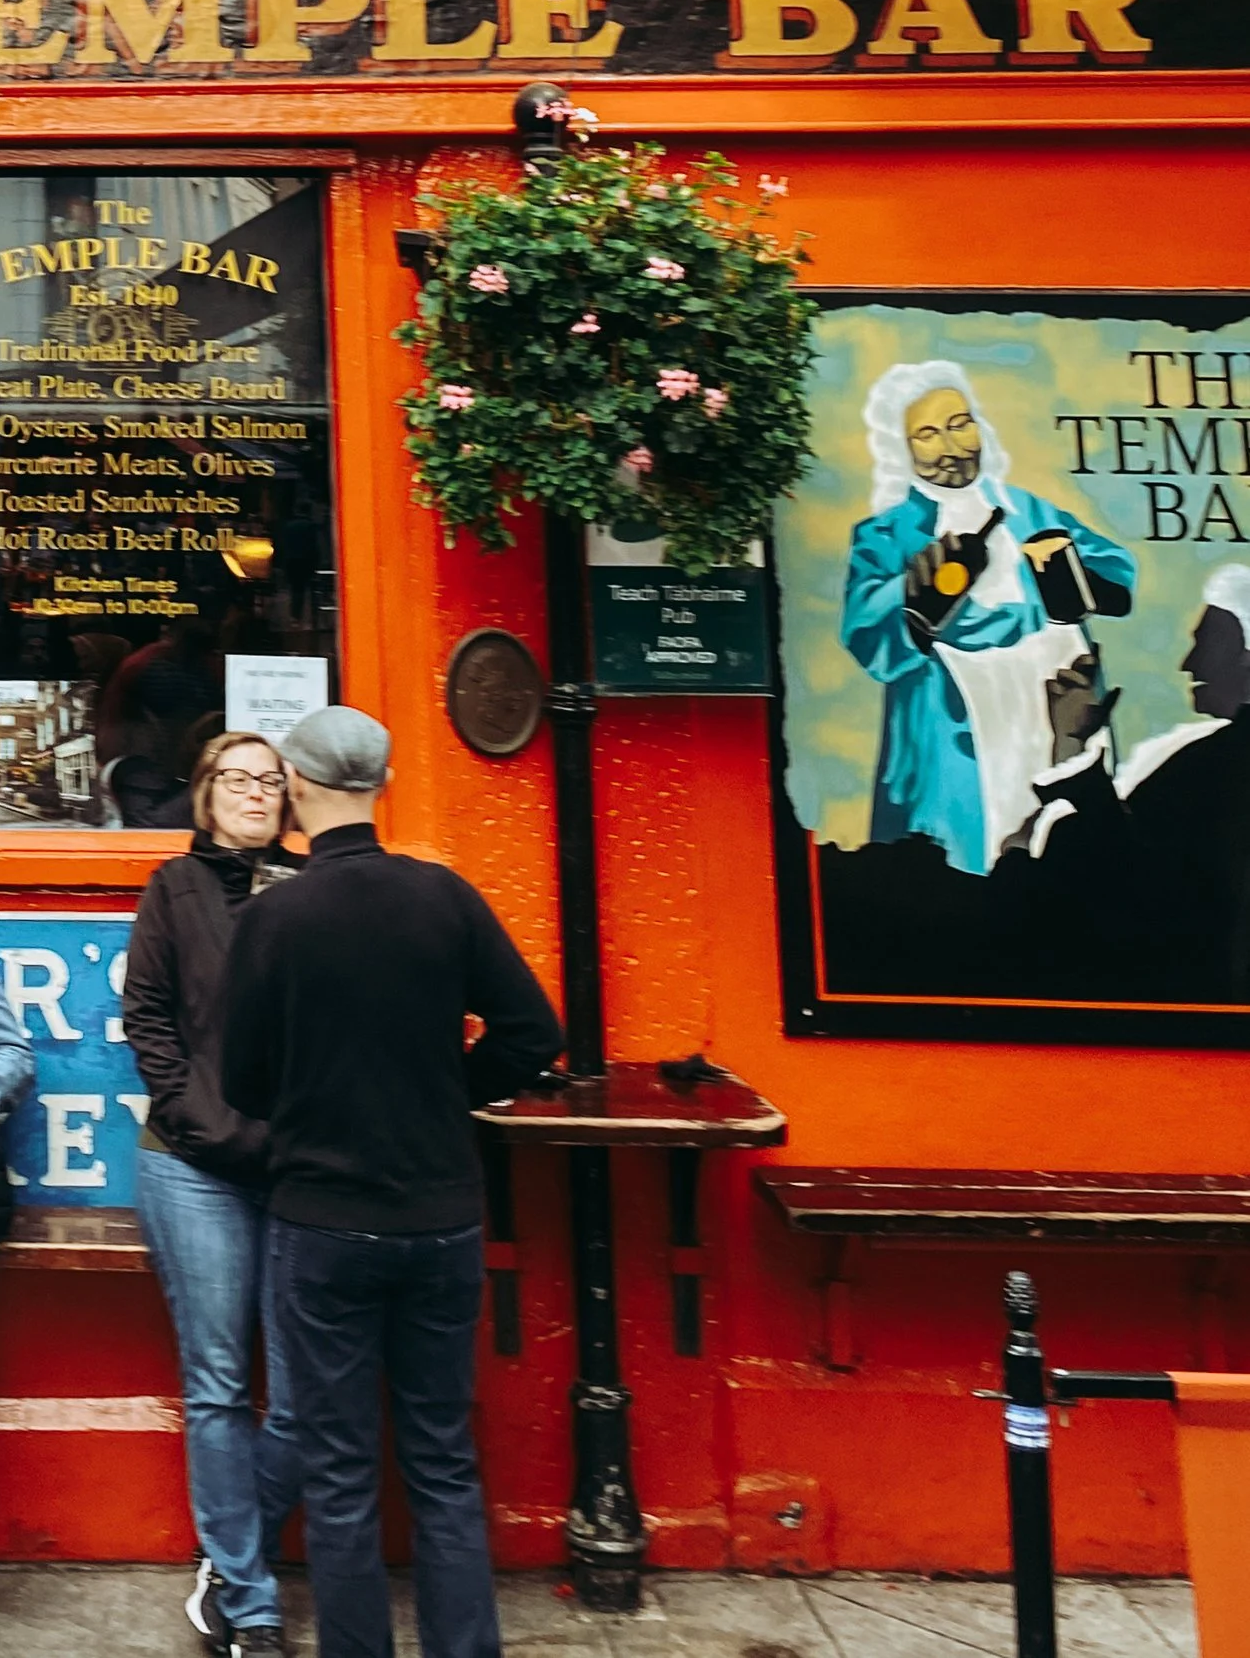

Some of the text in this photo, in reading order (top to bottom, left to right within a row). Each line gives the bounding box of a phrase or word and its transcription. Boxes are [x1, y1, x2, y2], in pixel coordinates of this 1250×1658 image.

[93, 199, 152, 226] The
[177, 240, 281, 295] BAR
[69, 283, 181, 309] Est. 1840
[134, 339, 199, 363] Food
[203, 339, 262, 364] Fare
[112, 374, 207, 402] Cheese
[208, 375, 288, 402] Board
[1126, 350, 1250, 409] TH
[103, 414, 206, 440] Smoked
[209, 415, 308, 441] Salmon
[1054, 415, 1250, 475] TEM
[101, 452, 188, 480] Meats,
[191, 452, 278, 479] Olives
[90, 488, 242, 515] Sandwiches
[1140, 481, 1250, 542] BA
[36, 526, 110, 552] Roast
[112, 526, 180, 552] Beef
